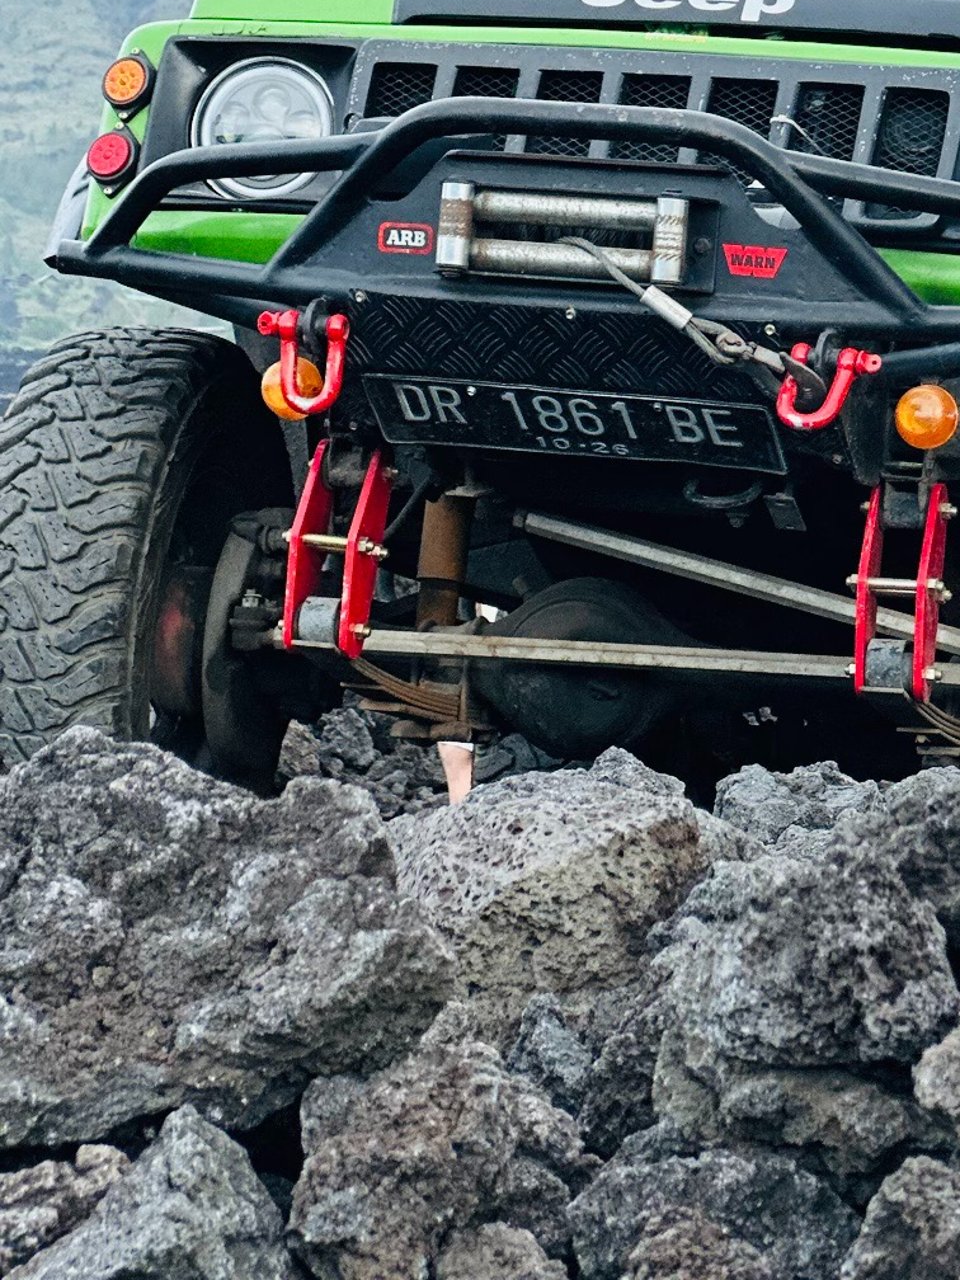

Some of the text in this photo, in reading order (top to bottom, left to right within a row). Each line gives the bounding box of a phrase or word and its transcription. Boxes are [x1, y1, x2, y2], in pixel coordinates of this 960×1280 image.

[386, 229, 426, 247] ARB
[730, 253, 776, 269] WARN
[398, 383, 743, 448] DR 1861 BE
